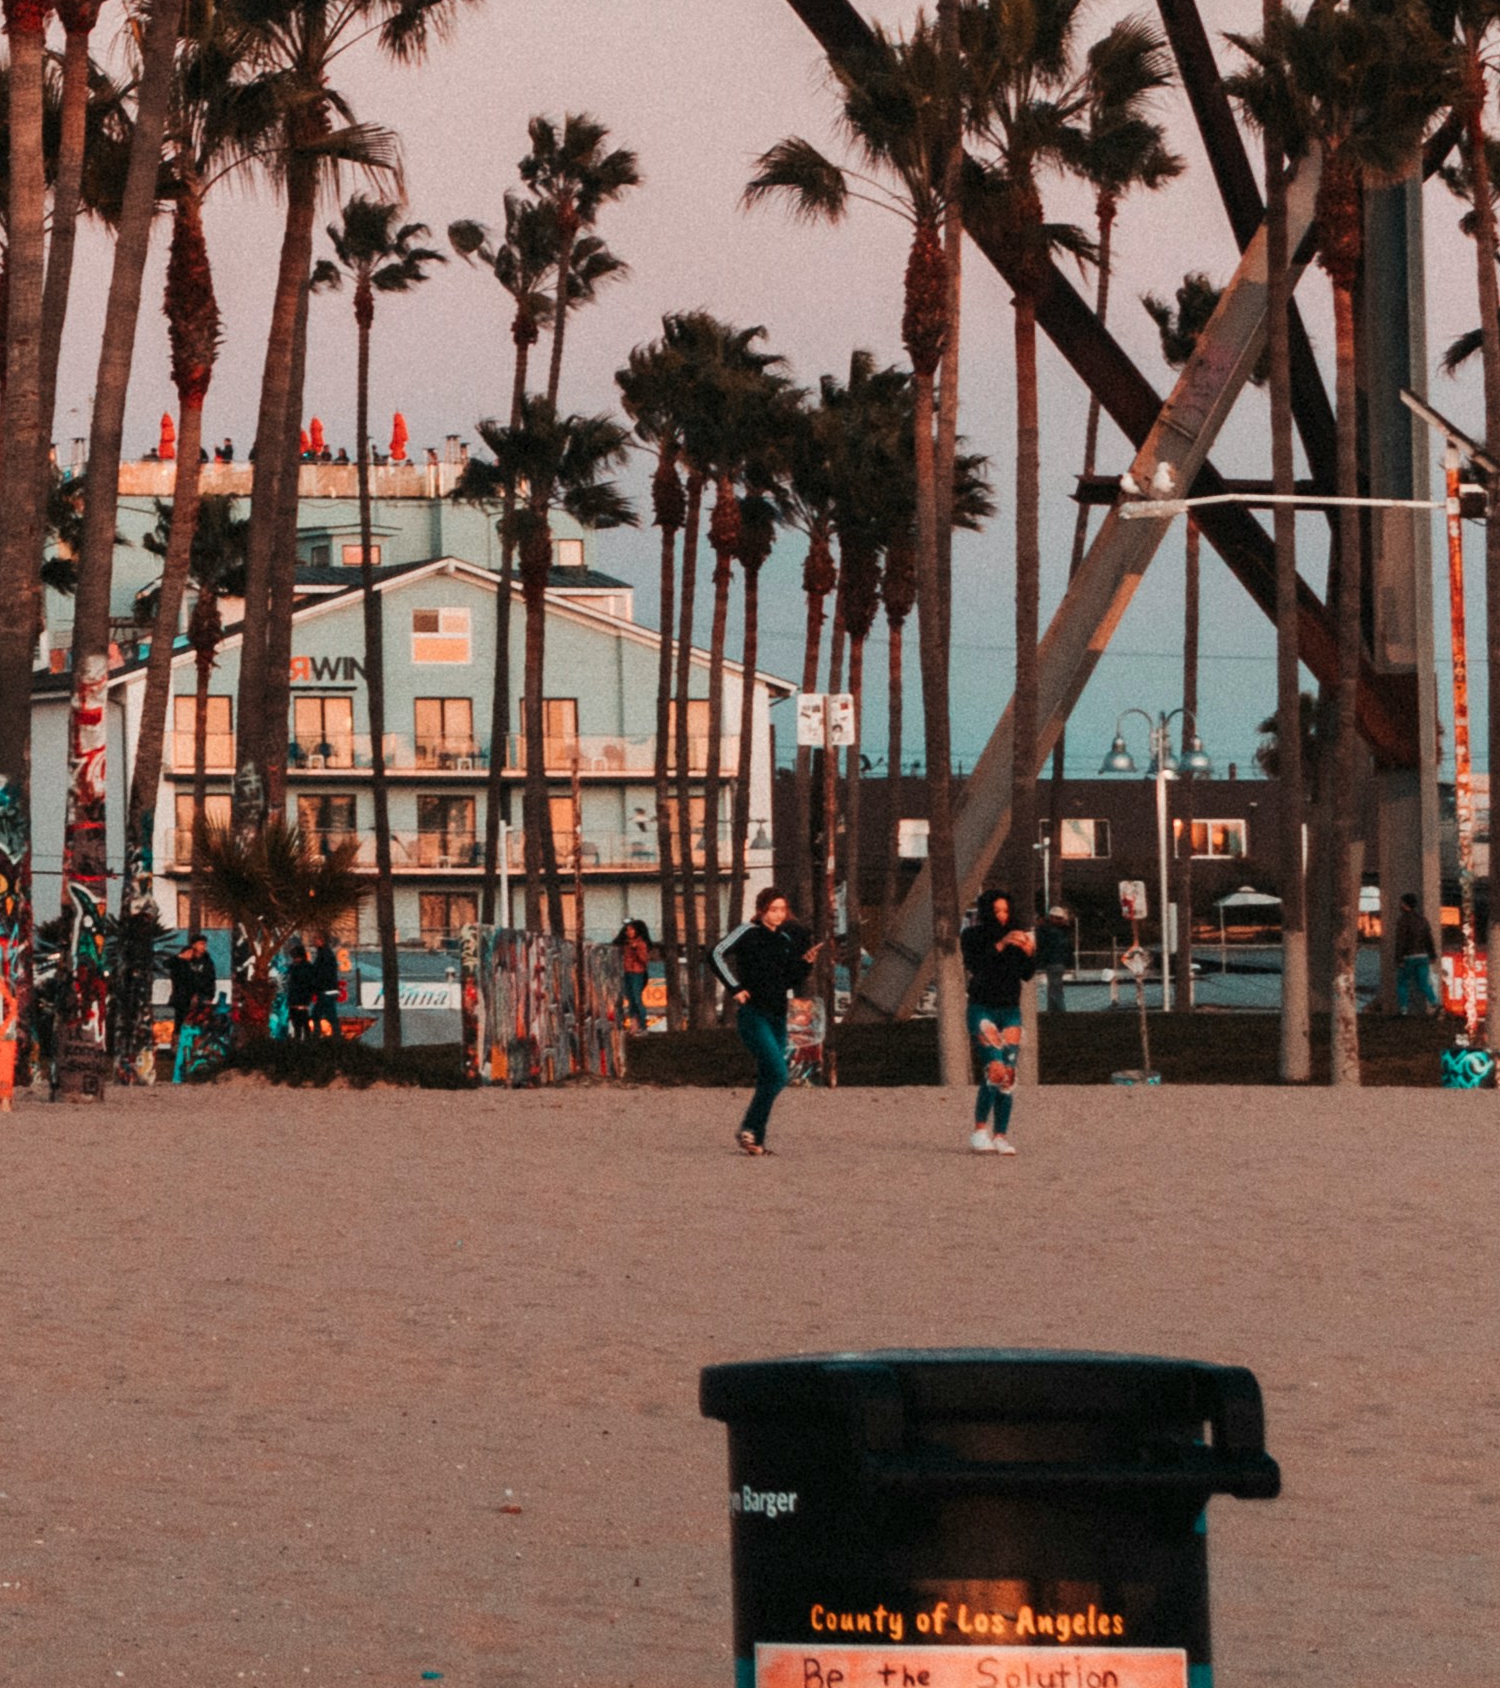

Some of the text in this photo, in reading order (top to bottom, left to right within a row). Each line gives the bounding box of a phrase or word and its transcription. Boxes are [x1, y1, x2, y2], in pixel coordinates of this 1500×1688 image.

[289, 655, 367, 681] RWIN
[742, 1484, 798, 1519] Barger
[810, 1601, 1124, 1642] County of Los Angeles
[803, 1656, 1119, 1688] Be the Solution
